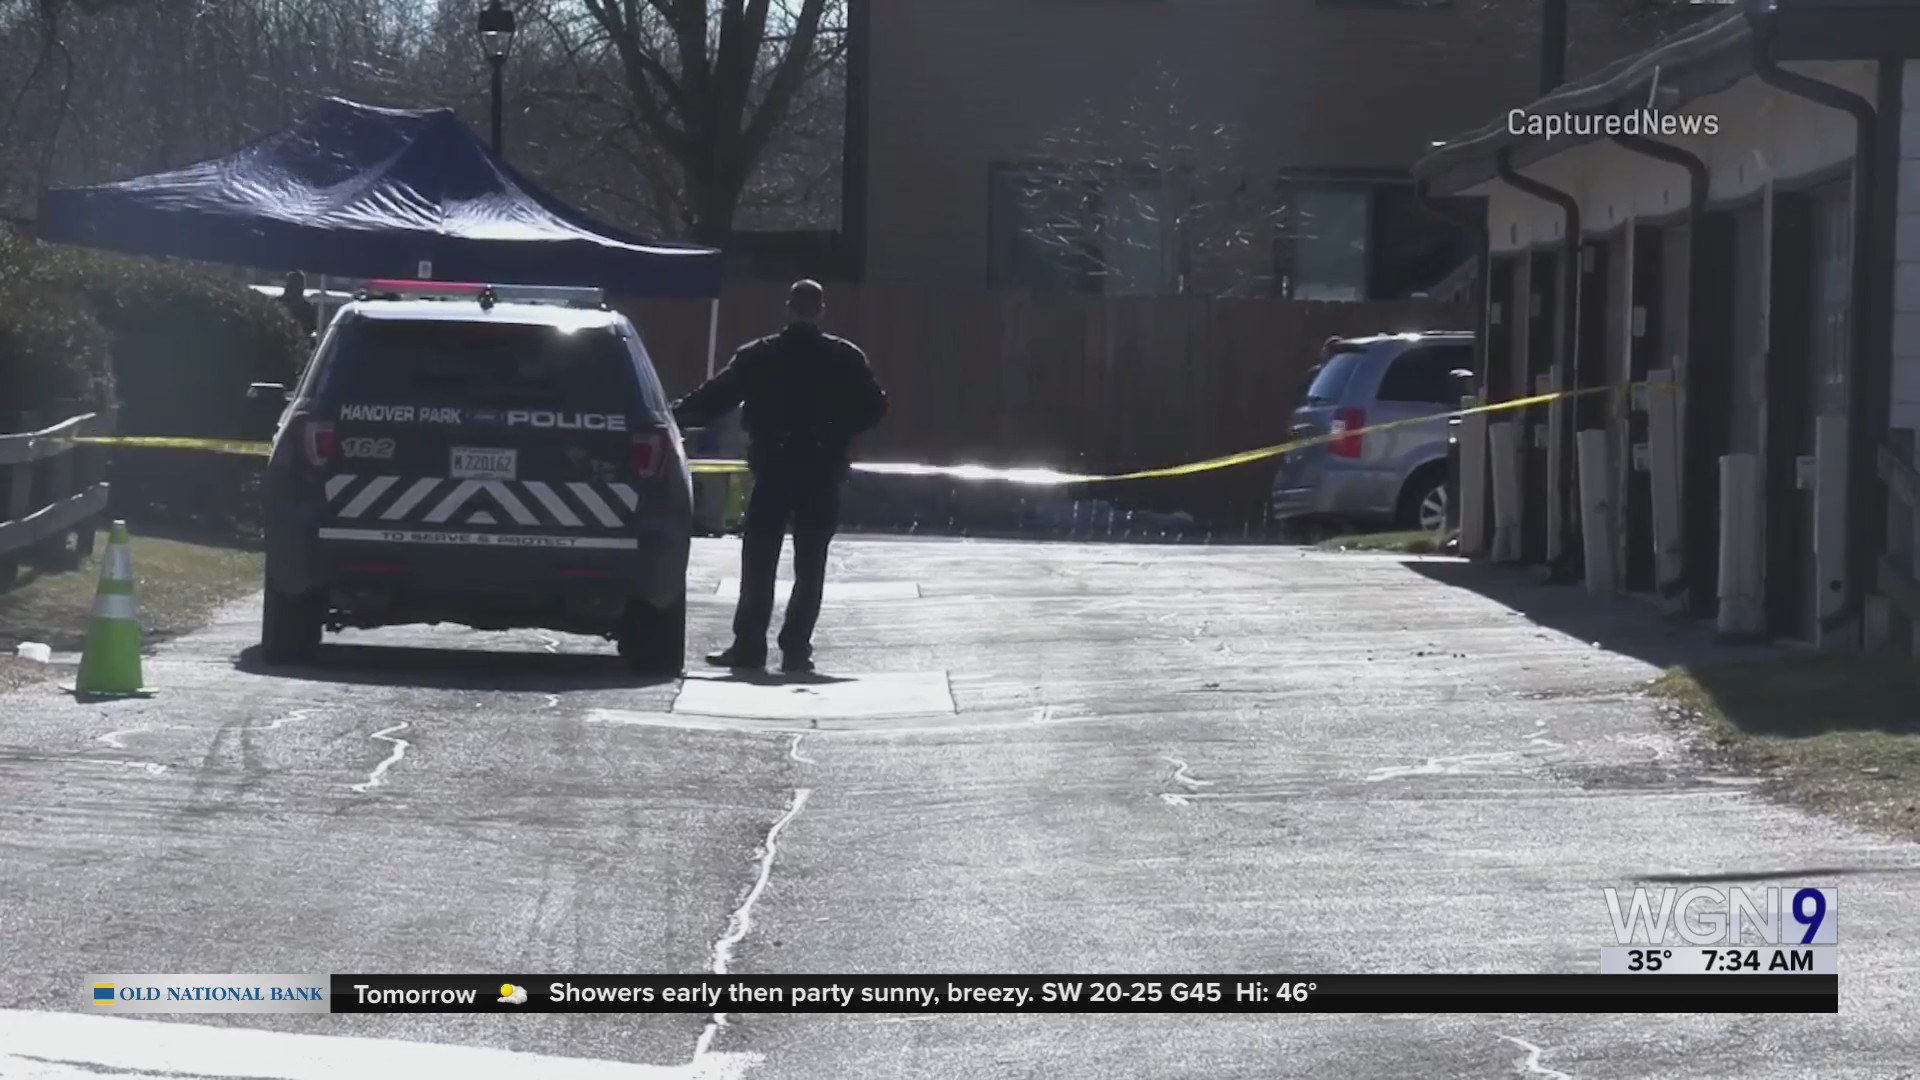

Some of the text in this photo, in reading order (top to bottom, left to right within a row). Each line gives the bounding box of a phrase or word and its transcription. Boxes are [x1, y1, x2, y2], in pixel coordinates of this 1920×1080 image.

[341, 404, 415, 421] HANOVER
[419, 408, 462, 424] PARK
[507, 410, 627, 432] POLICE
[341, 437, 397, 459] 162
[382, 532, 404, 541] TO
[410, 533, 470, 543] SERVE
[498, 535, 577, 546] PROTECT
